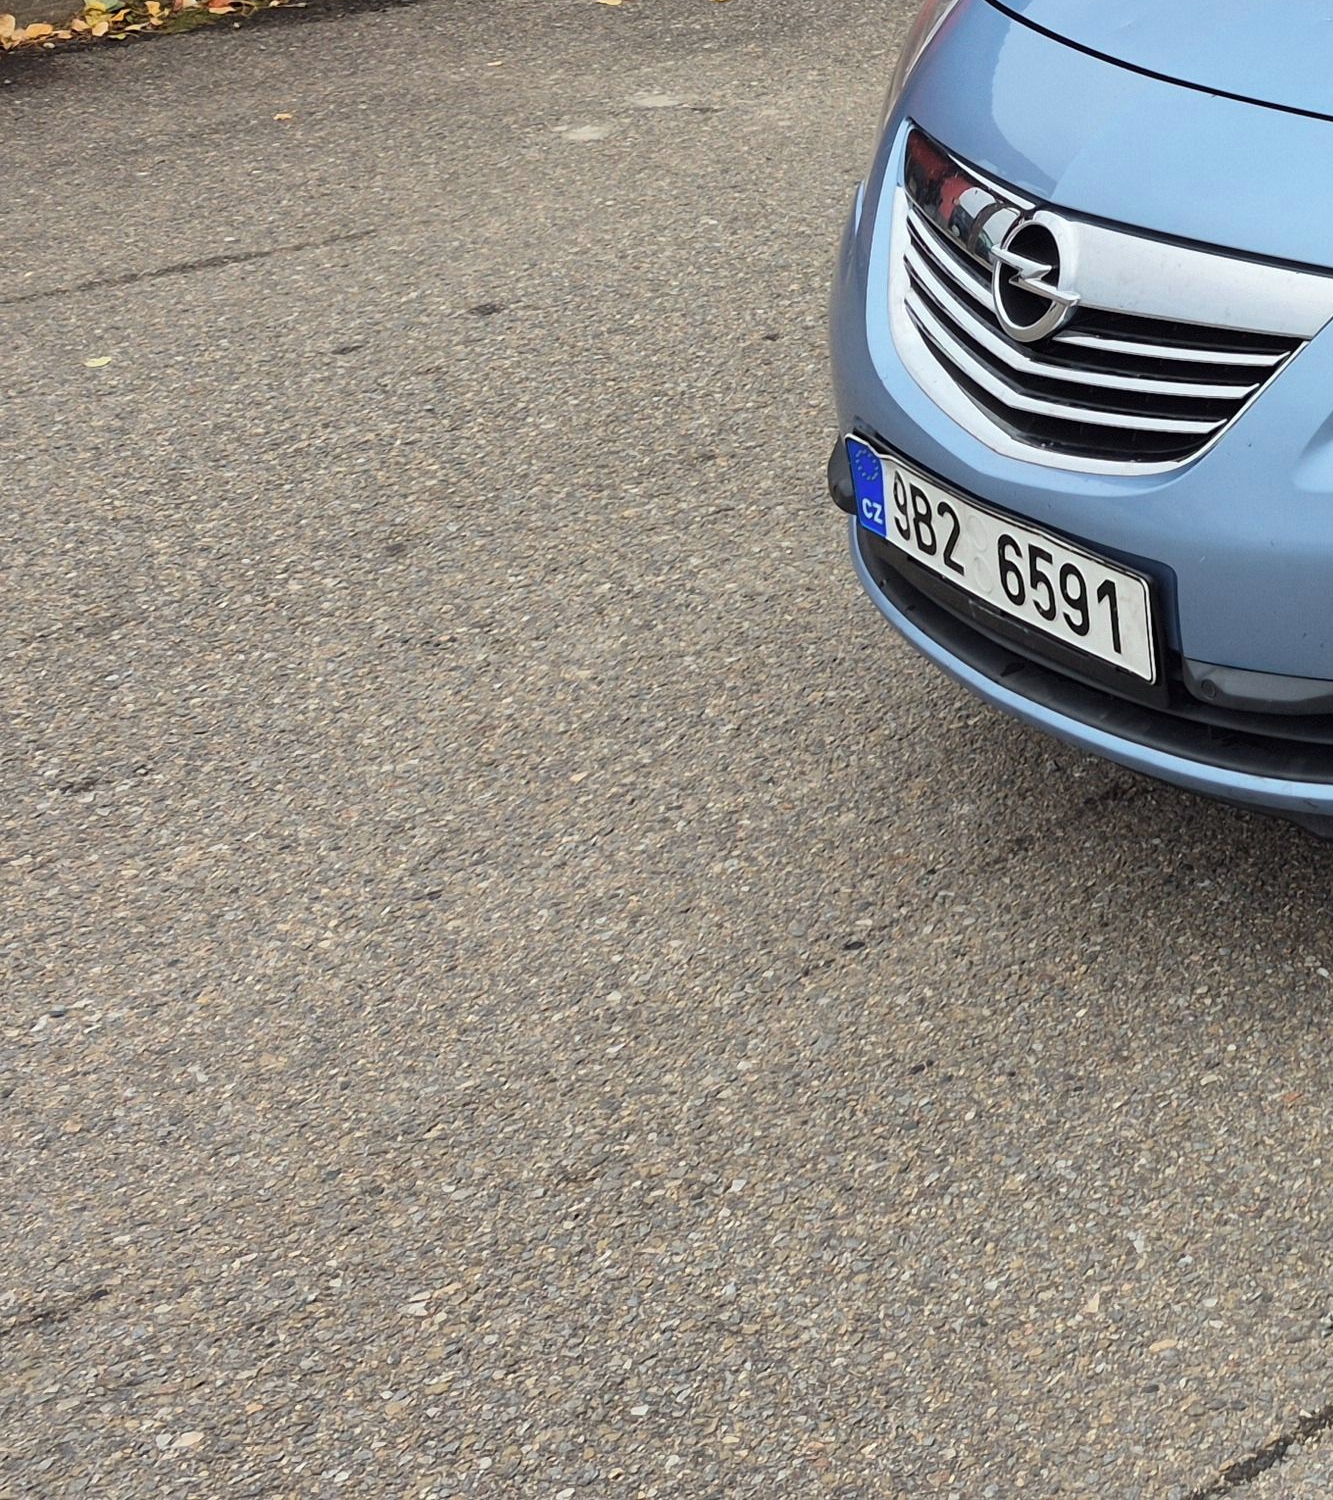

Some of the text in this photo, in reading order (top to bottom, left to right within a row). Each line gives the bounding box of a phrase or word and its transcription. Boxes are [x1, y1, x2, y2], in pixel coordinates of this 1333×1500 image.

[862, 498, 883, 525] CZ
[893, 470, 1122, 655] 9B2 6591
